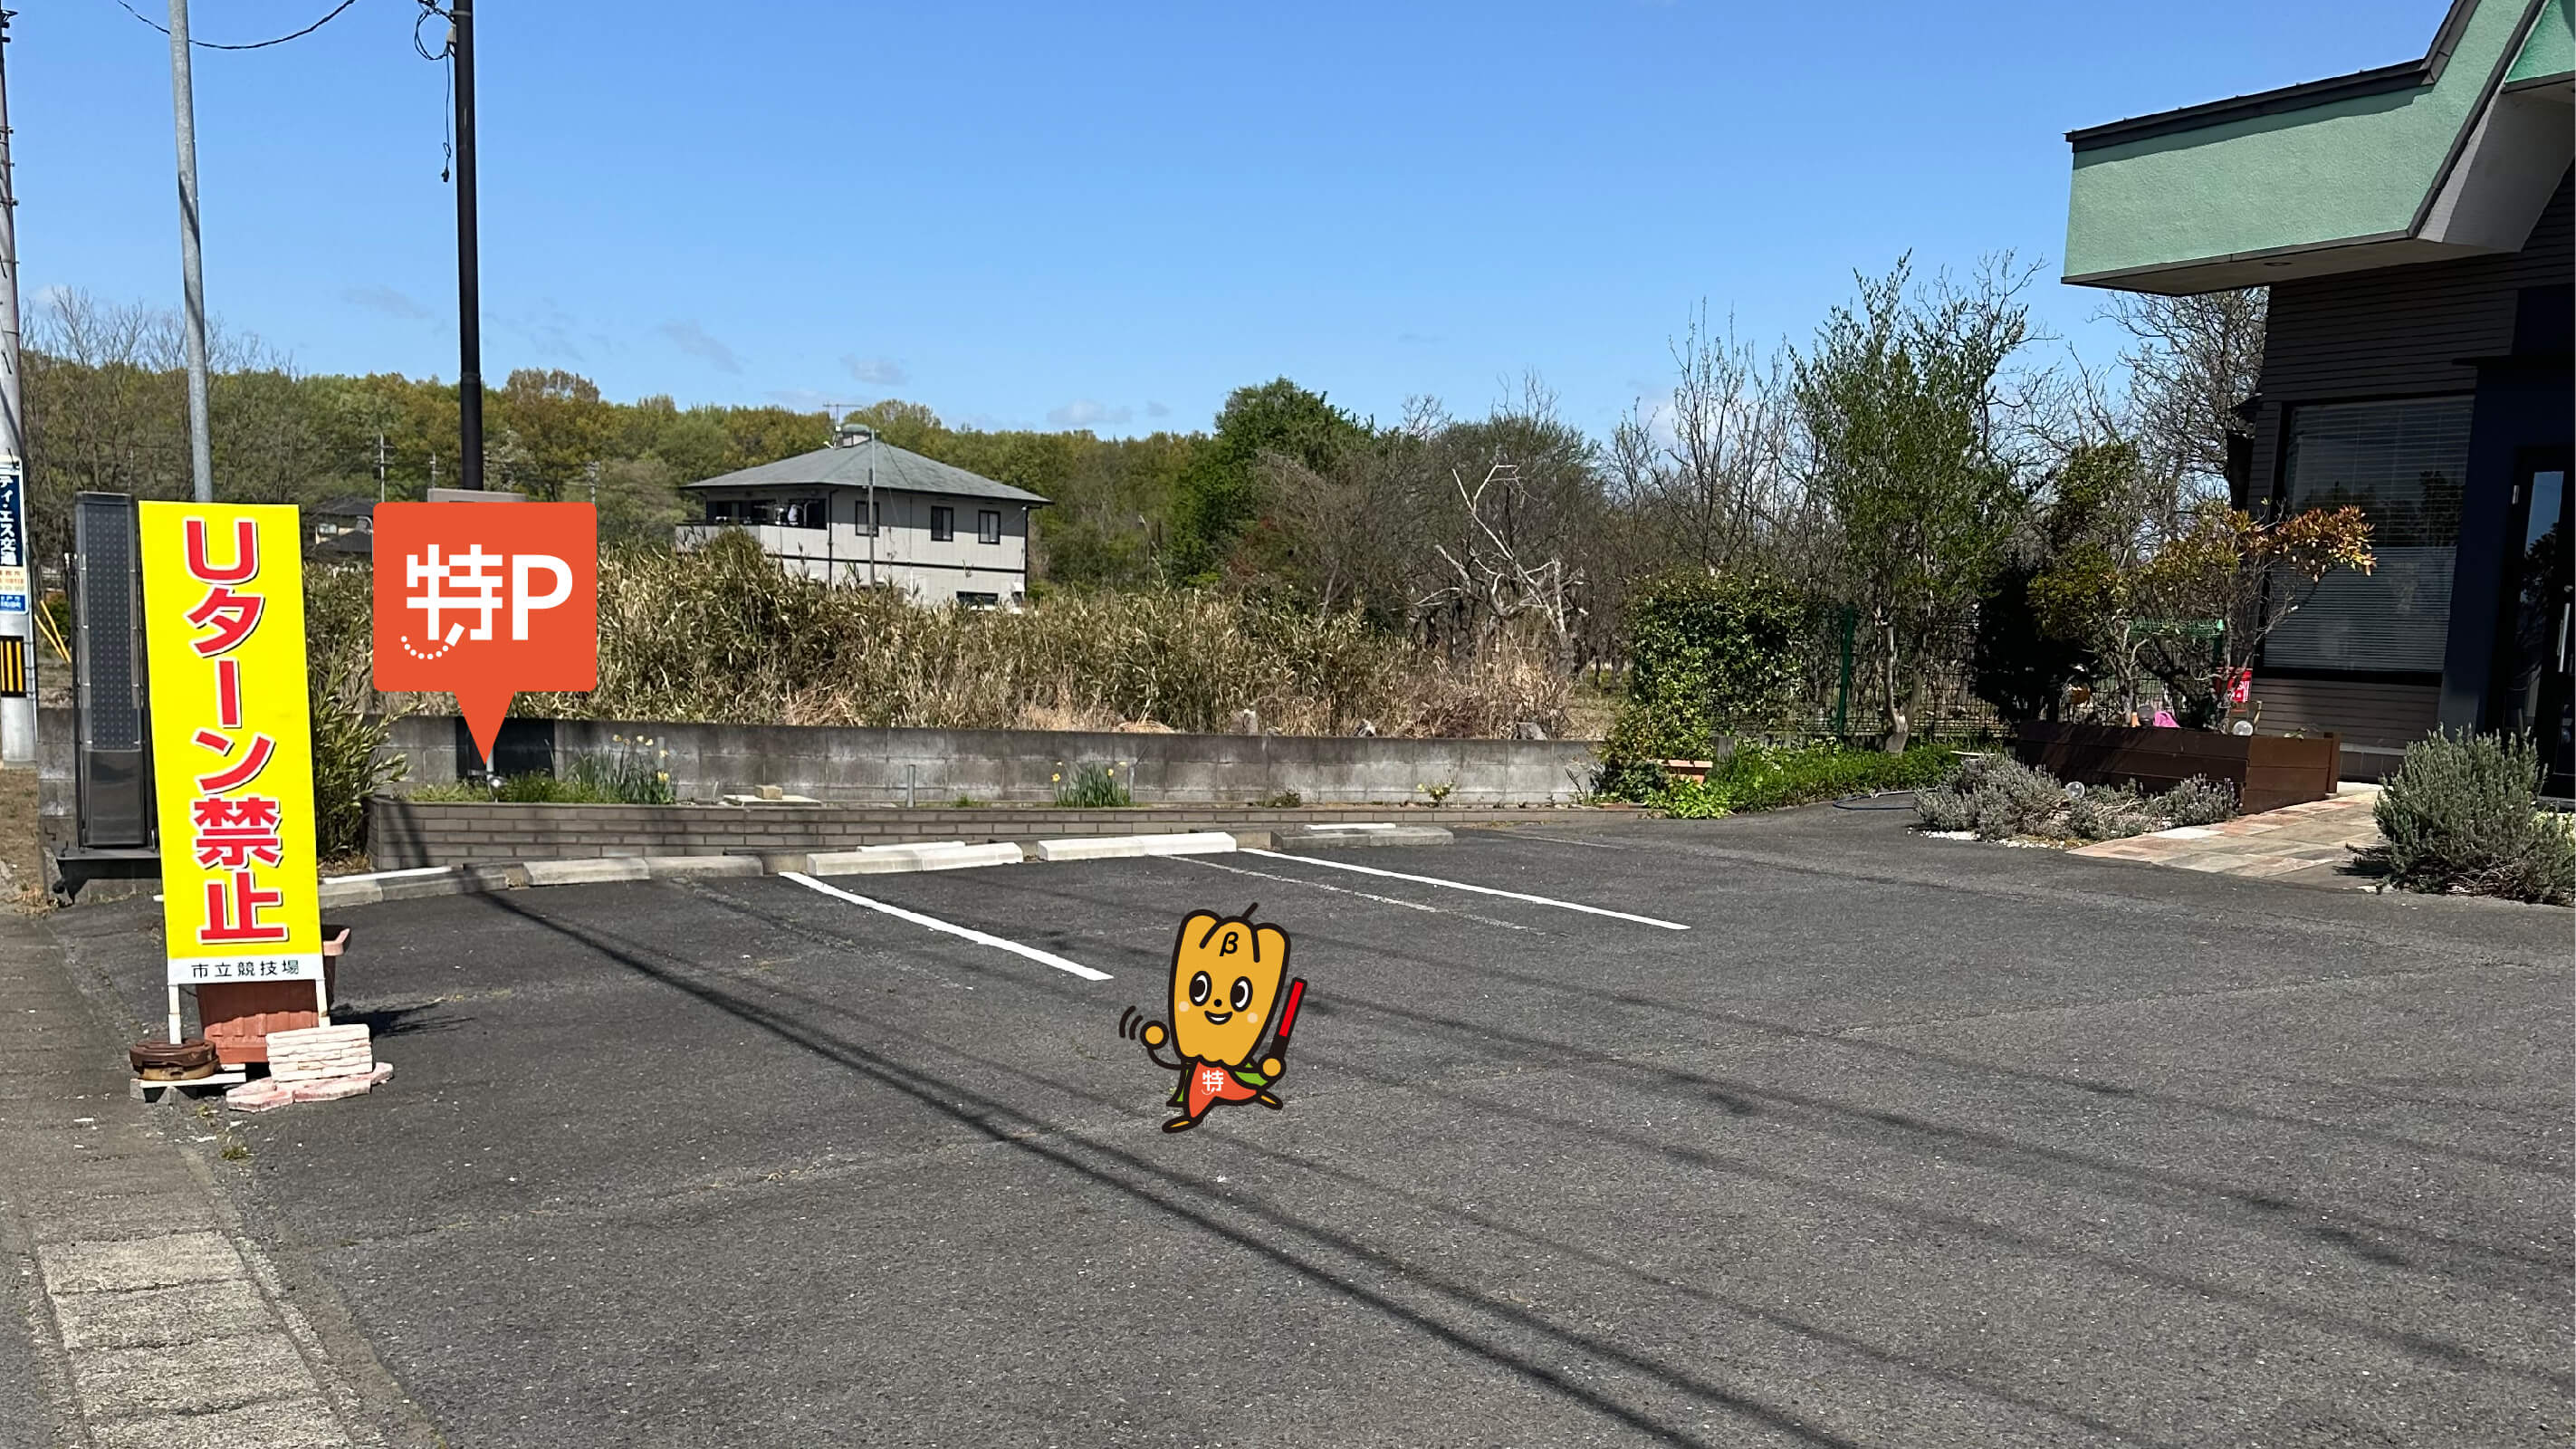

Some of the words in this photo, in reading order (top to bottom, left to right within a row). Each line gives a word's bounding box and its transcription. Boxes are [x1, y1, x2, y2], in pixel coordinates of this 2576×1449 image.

[186, 520, 286, 942] Uターン禁止
[191, 959, 300, 979] 市立競技場
